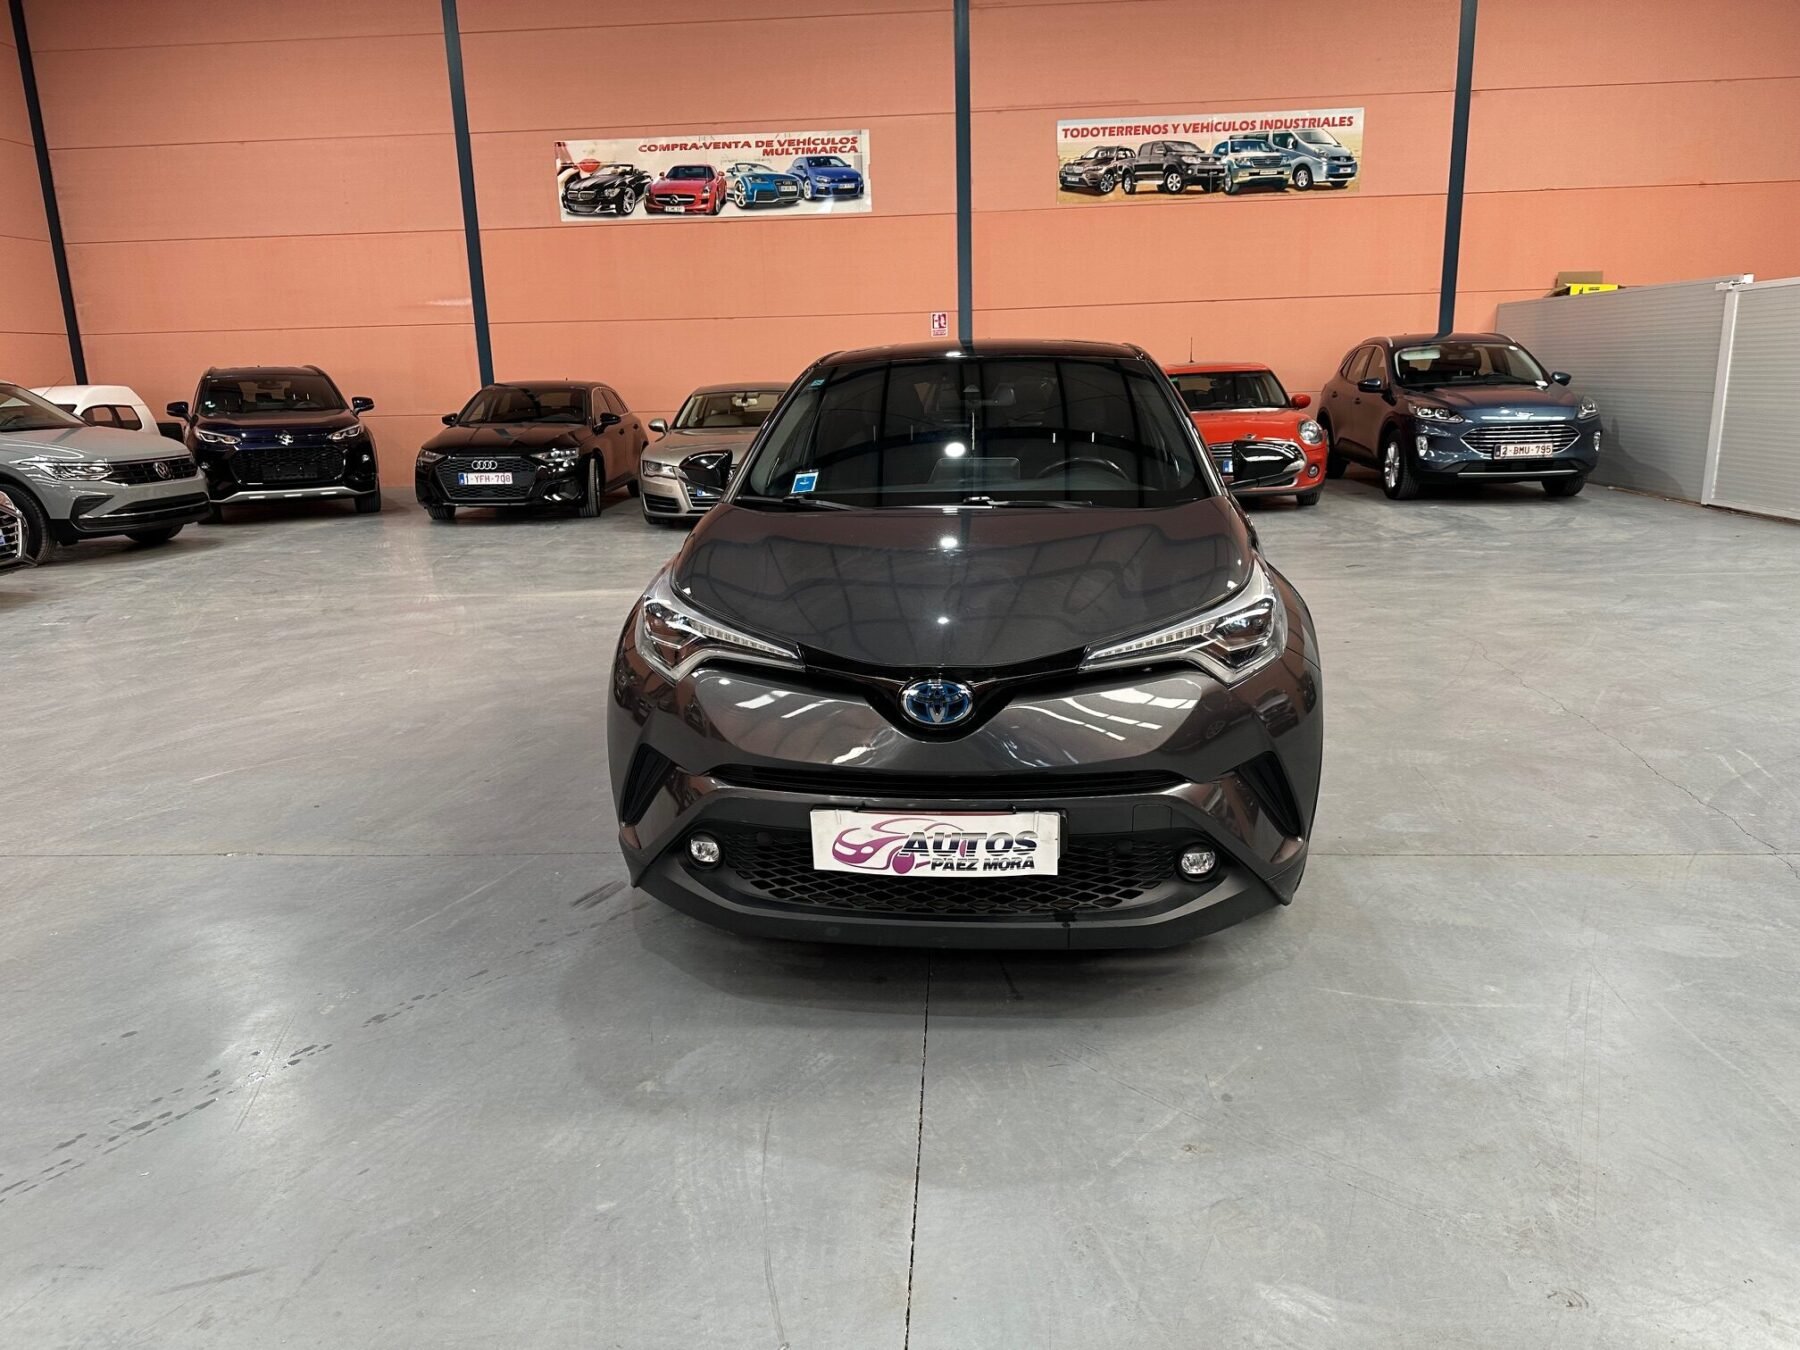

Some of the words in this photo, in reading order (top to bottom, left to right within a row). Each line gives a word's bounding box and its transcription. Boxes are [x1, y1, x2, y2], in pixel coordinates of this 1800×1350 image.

[1062, 124, 1169, 139] TODOTERRENOS
[1171, 123, 1180, 134] Y
[1259, 116, 1354, 130] INDUSTRIALES
[638, 140, 752, 153] COMPRA-VENTA
[755, 140, 774, 148] DE
[762, 145, 859, 157] MULTIMARCA
[1502, 445, 1552, 456] 2-BMU-795
[899, 830, 1038, 857] AUTOS
[983, 856, 1035, 871] MORA
